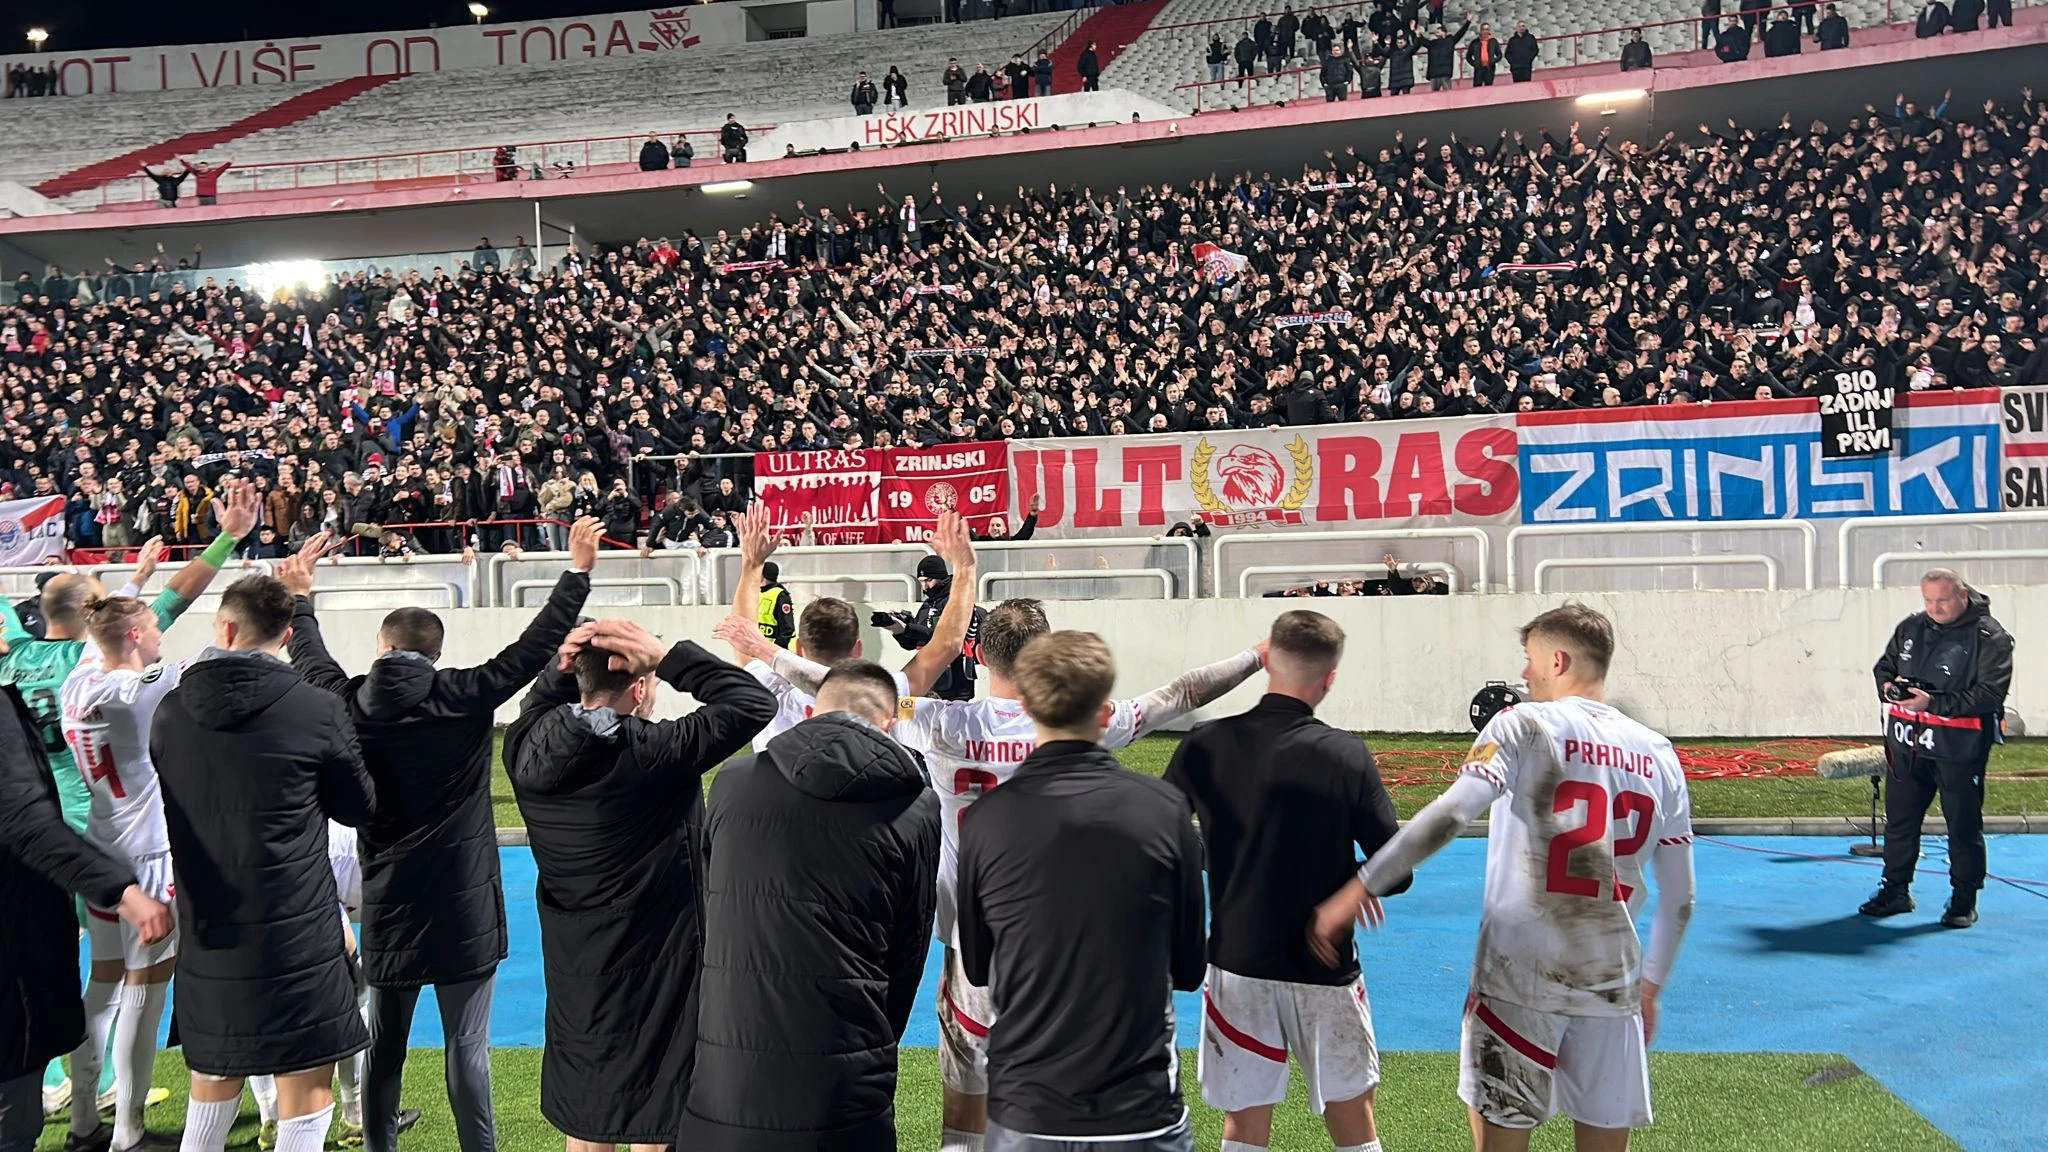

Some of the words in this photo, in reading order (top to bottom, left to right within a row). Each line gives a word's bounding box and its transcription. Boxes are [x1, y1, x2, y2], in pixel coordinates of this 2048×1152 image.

[483, 20, 635, 65] TOGA
[865, 112, 918, 143] HŠK
[924, 102, 1039, 139] ZRINJSKI
[1834, 370, 1877, 394] BIO
[1819, 387, 1895, 415] ZADNJI
[2004, 392, 2048, 433] SV
[1846, 411, 1876, 432] ILI
[1836, 427, 1890, 453] PRVI
[768, 449, 866, 473] ULTRAS
[895, 450, 986, 472] ZRINJSKI
[1530, 434, 1988, 521] ZRINJSKI
[2005, 467, 2048, 508] SA
[888, 490, 912, 508] 19
[969, 484, 997, 504] 05
[1226, 511, 1268, 525] 1994
[822, 532, 838, 546] OF
[1546, 779, 1656, 903] 22
